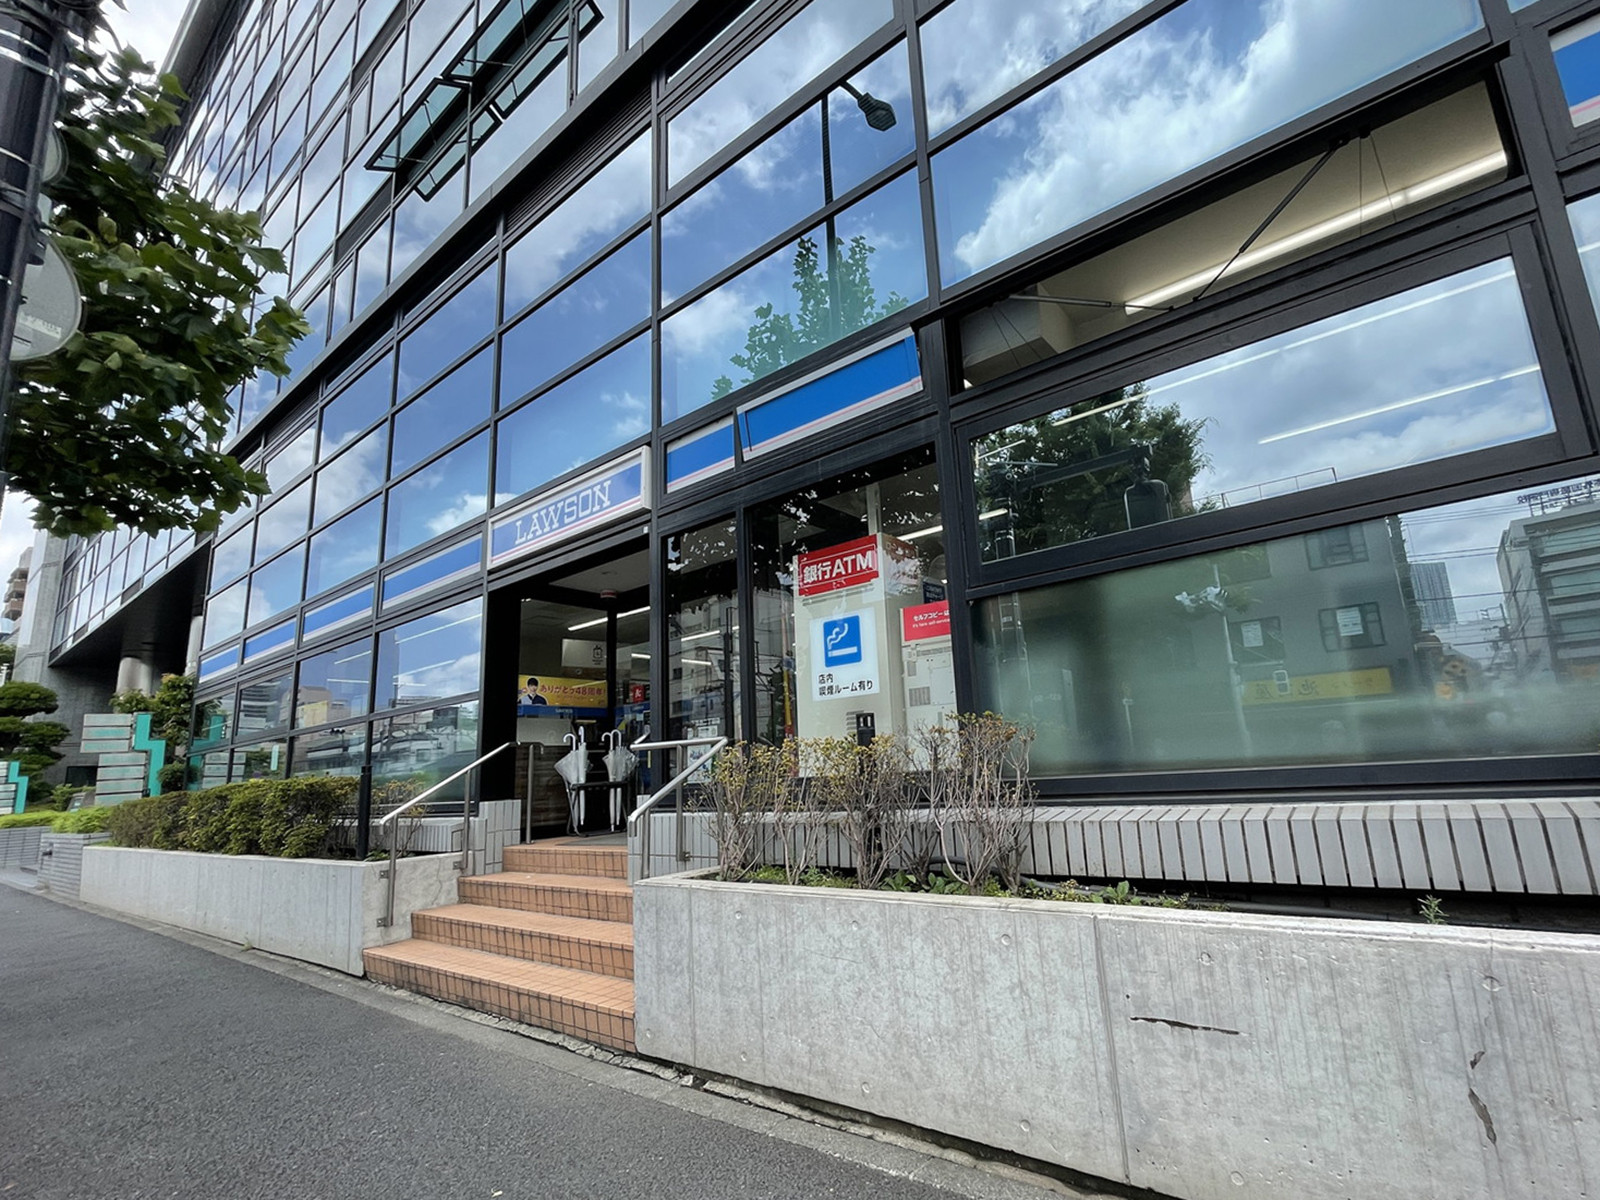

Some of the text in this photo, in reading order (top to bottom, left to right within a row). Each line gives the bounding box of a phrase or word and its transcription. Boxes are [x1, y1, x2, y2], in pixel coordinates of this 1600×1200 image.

[515, 480, 611, 545] LAWSON
[803, 550, 873, 583] 銀行ATM
[818, 673, 834, 684] 店内
[818, 680, 873, 696] 喫煙ルーム有り
